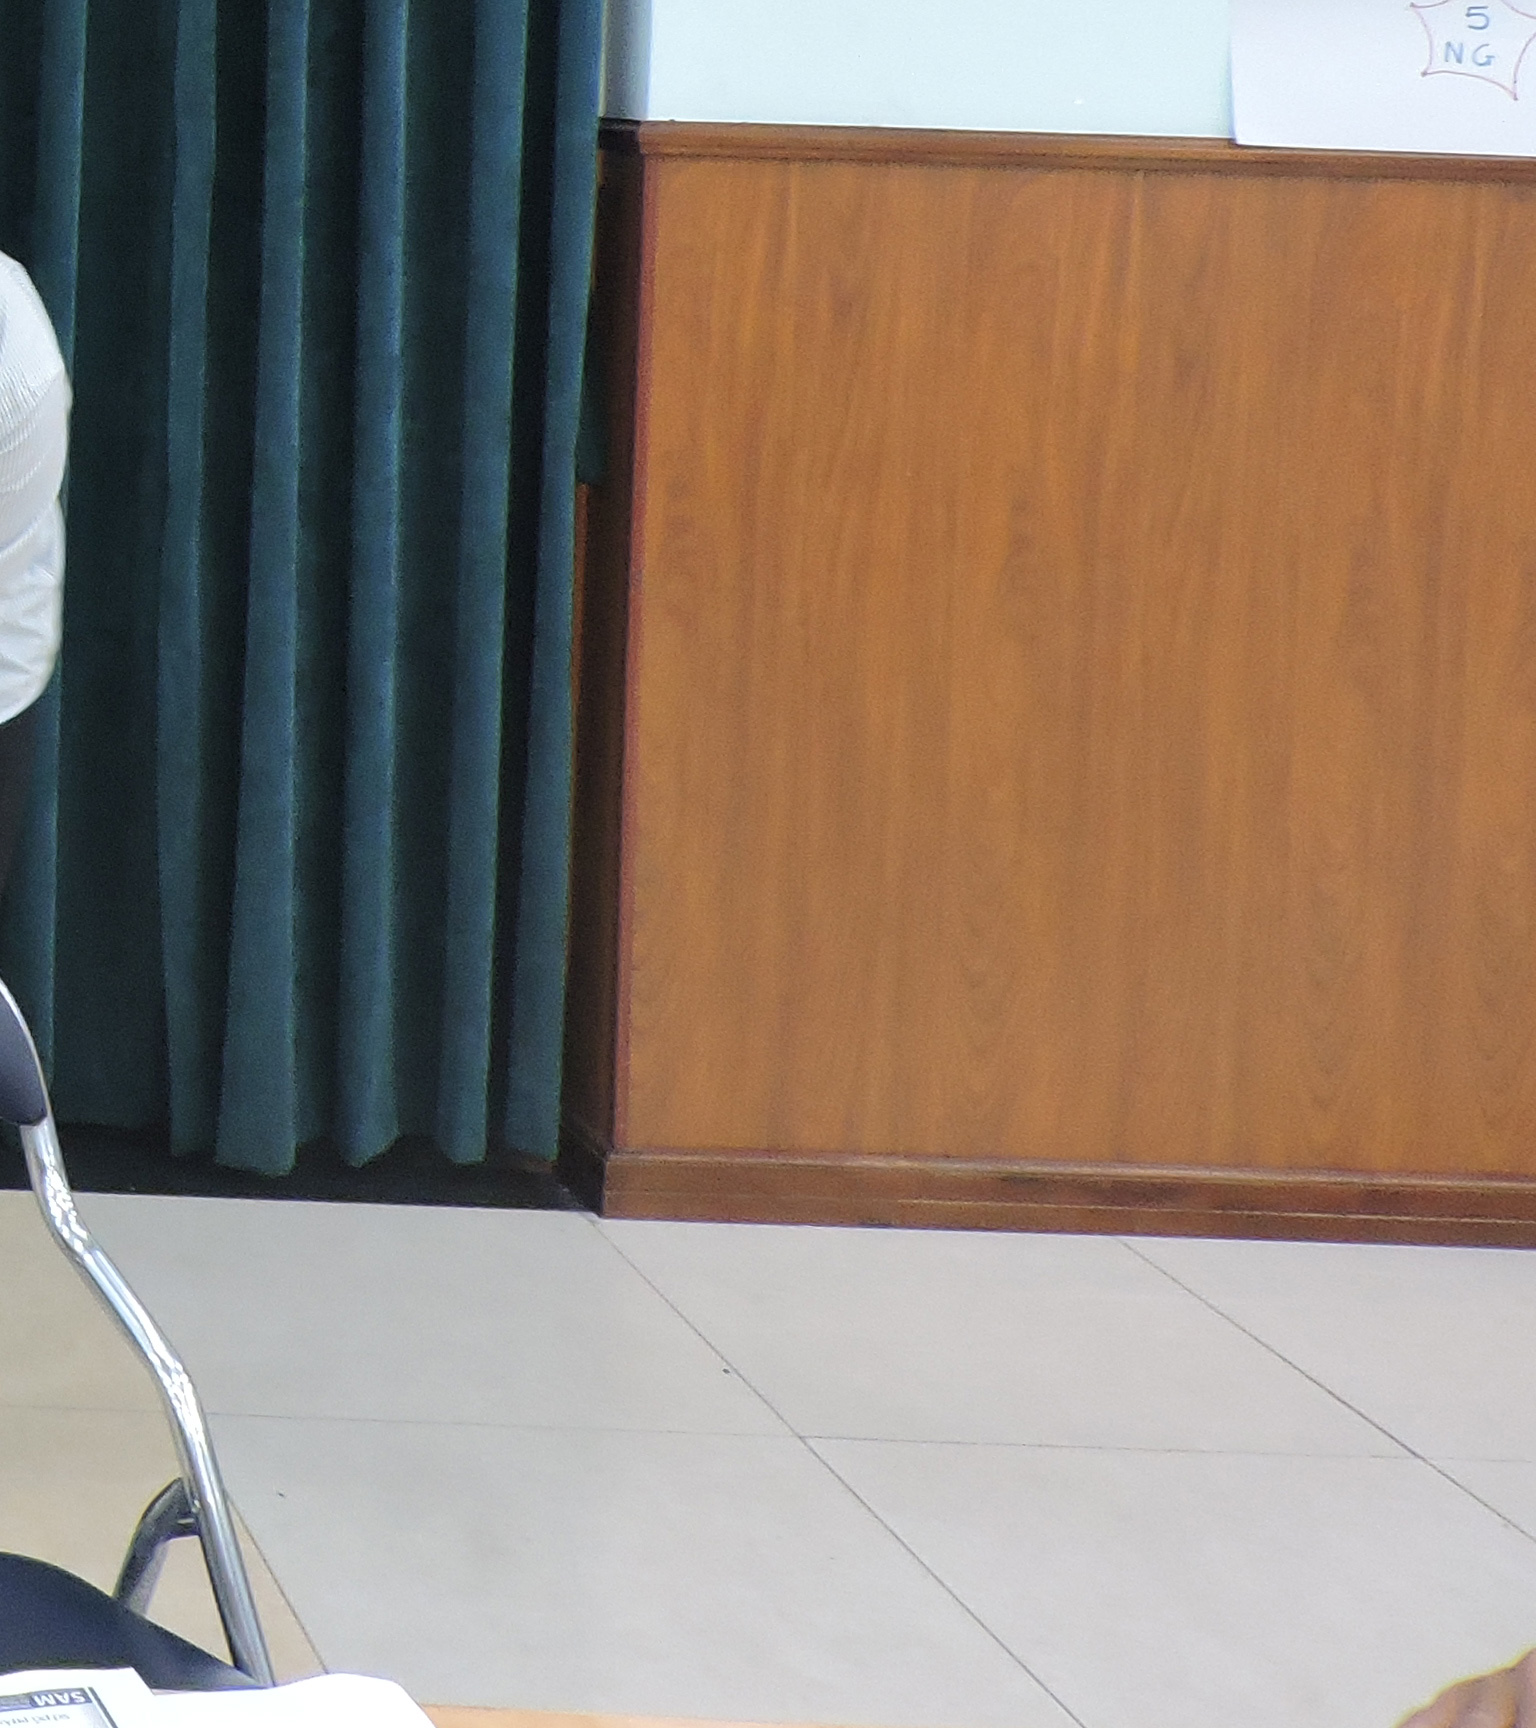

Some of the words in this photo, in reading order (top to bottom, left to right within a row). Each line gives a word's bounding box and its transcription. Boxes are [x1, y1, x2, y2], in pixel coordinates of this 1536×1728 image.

[1464, 5, 1491, 31] 5
[1444, 40, 1496, 67] NG
[33, 1690, 86, 1706] SAM
